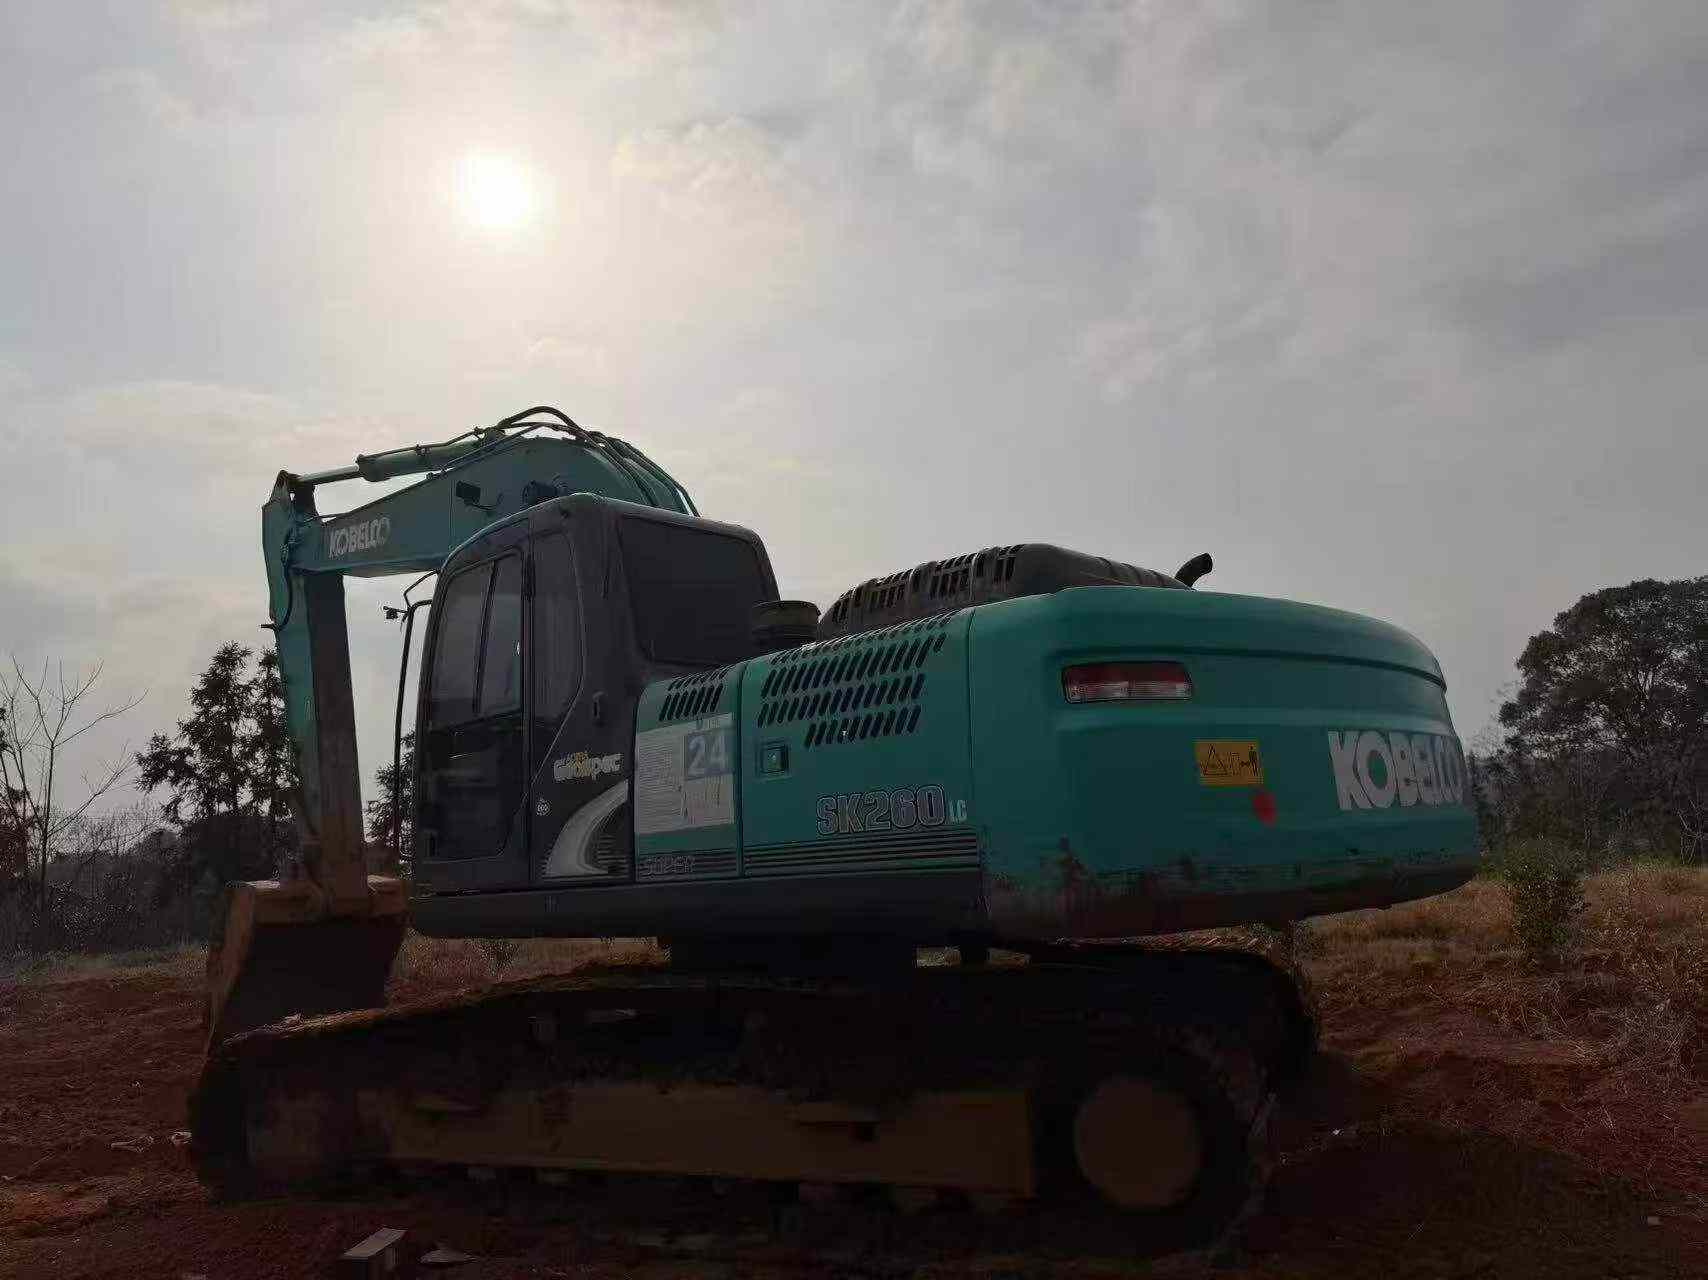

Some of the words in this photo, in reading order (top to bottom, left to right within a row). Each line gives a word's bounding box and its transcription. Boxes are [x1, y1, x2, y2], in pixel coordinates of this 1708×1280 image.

[328, 517, 390, 558] KOBELCO
[688, 735, 728, 773] 24
[816, 785, 947, 835] SK260
